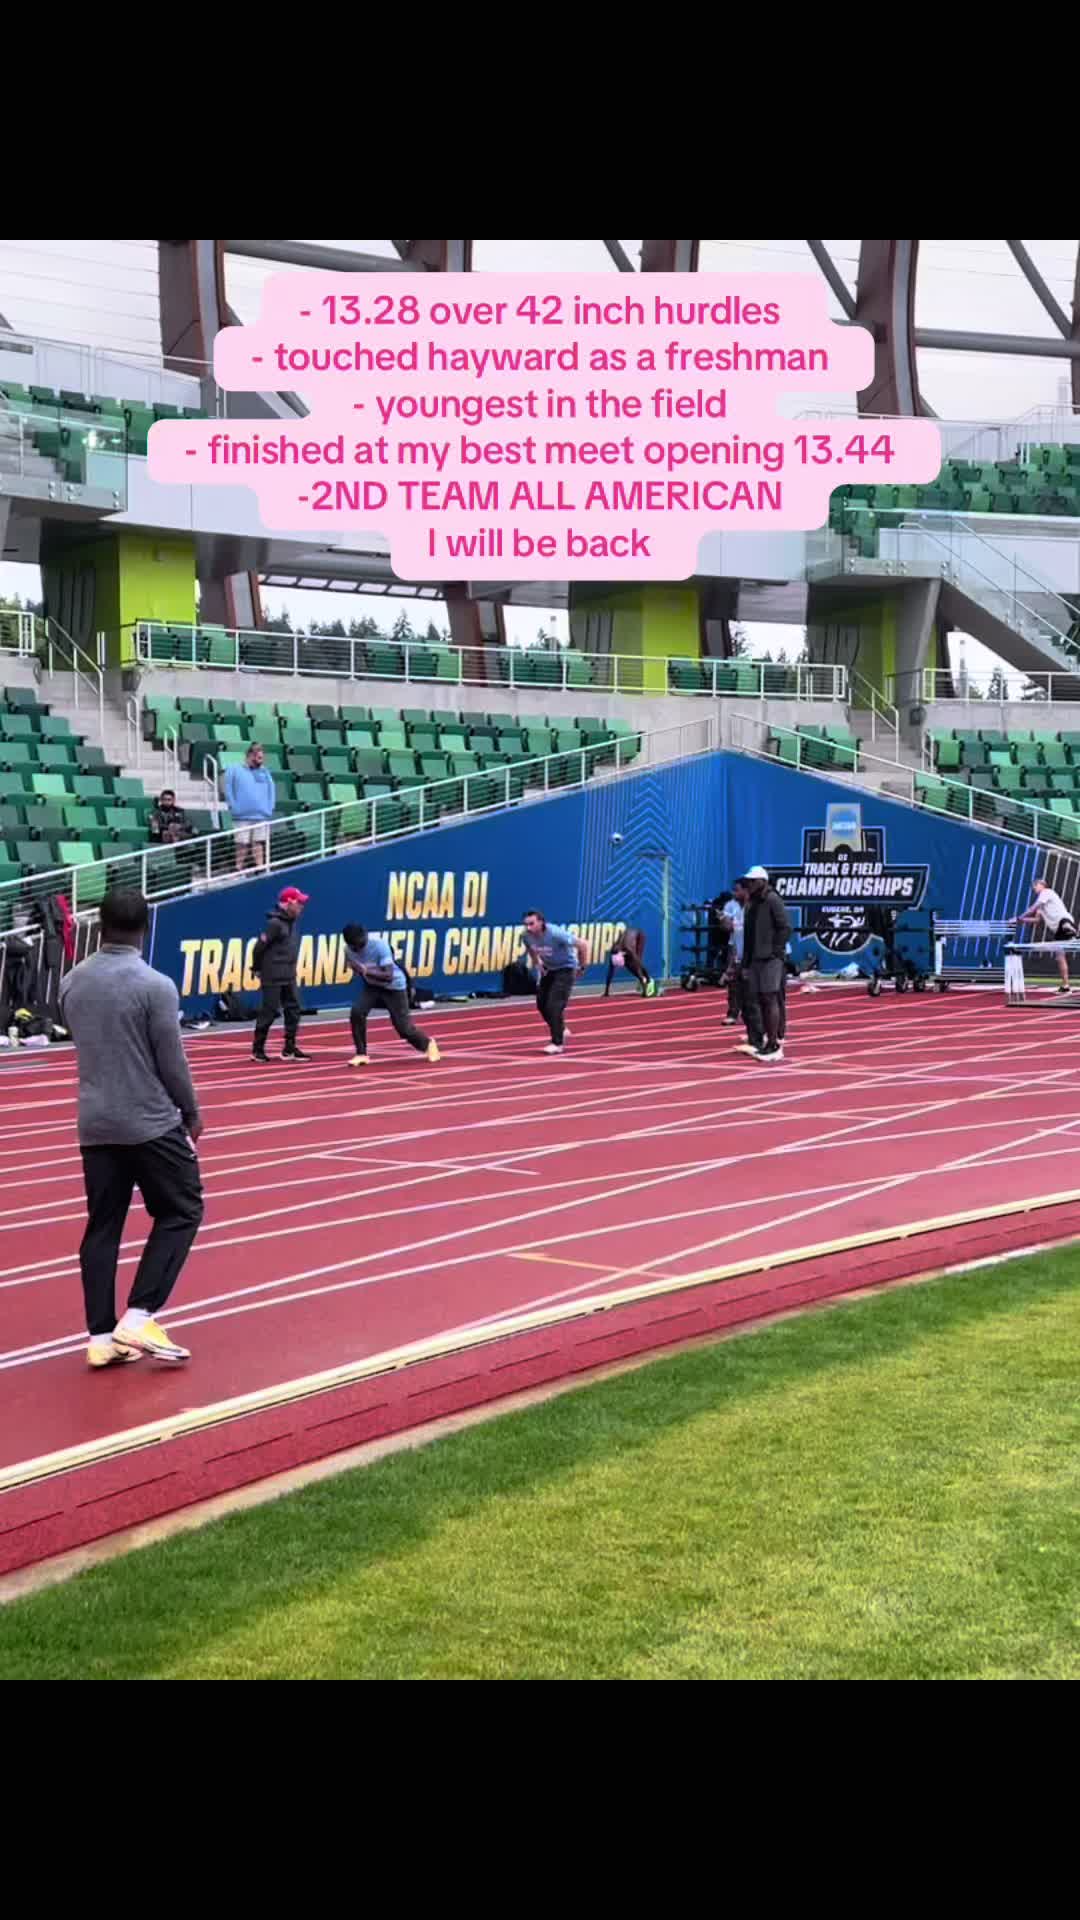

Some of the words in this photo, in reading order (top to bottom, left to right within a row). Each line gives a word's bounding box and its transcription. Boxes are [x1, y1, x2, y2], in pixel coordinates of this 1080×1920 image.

[804, 863, 839, 876] TRACK
[851, 862, 883, 876] FIELD
[386, 870, 455, 921] NCAA
[461, 870, 489, 918] DI
[775, 877, 914, 897] CHAMPIONSHIPS
[180, 937, 263, 997] TRAC
